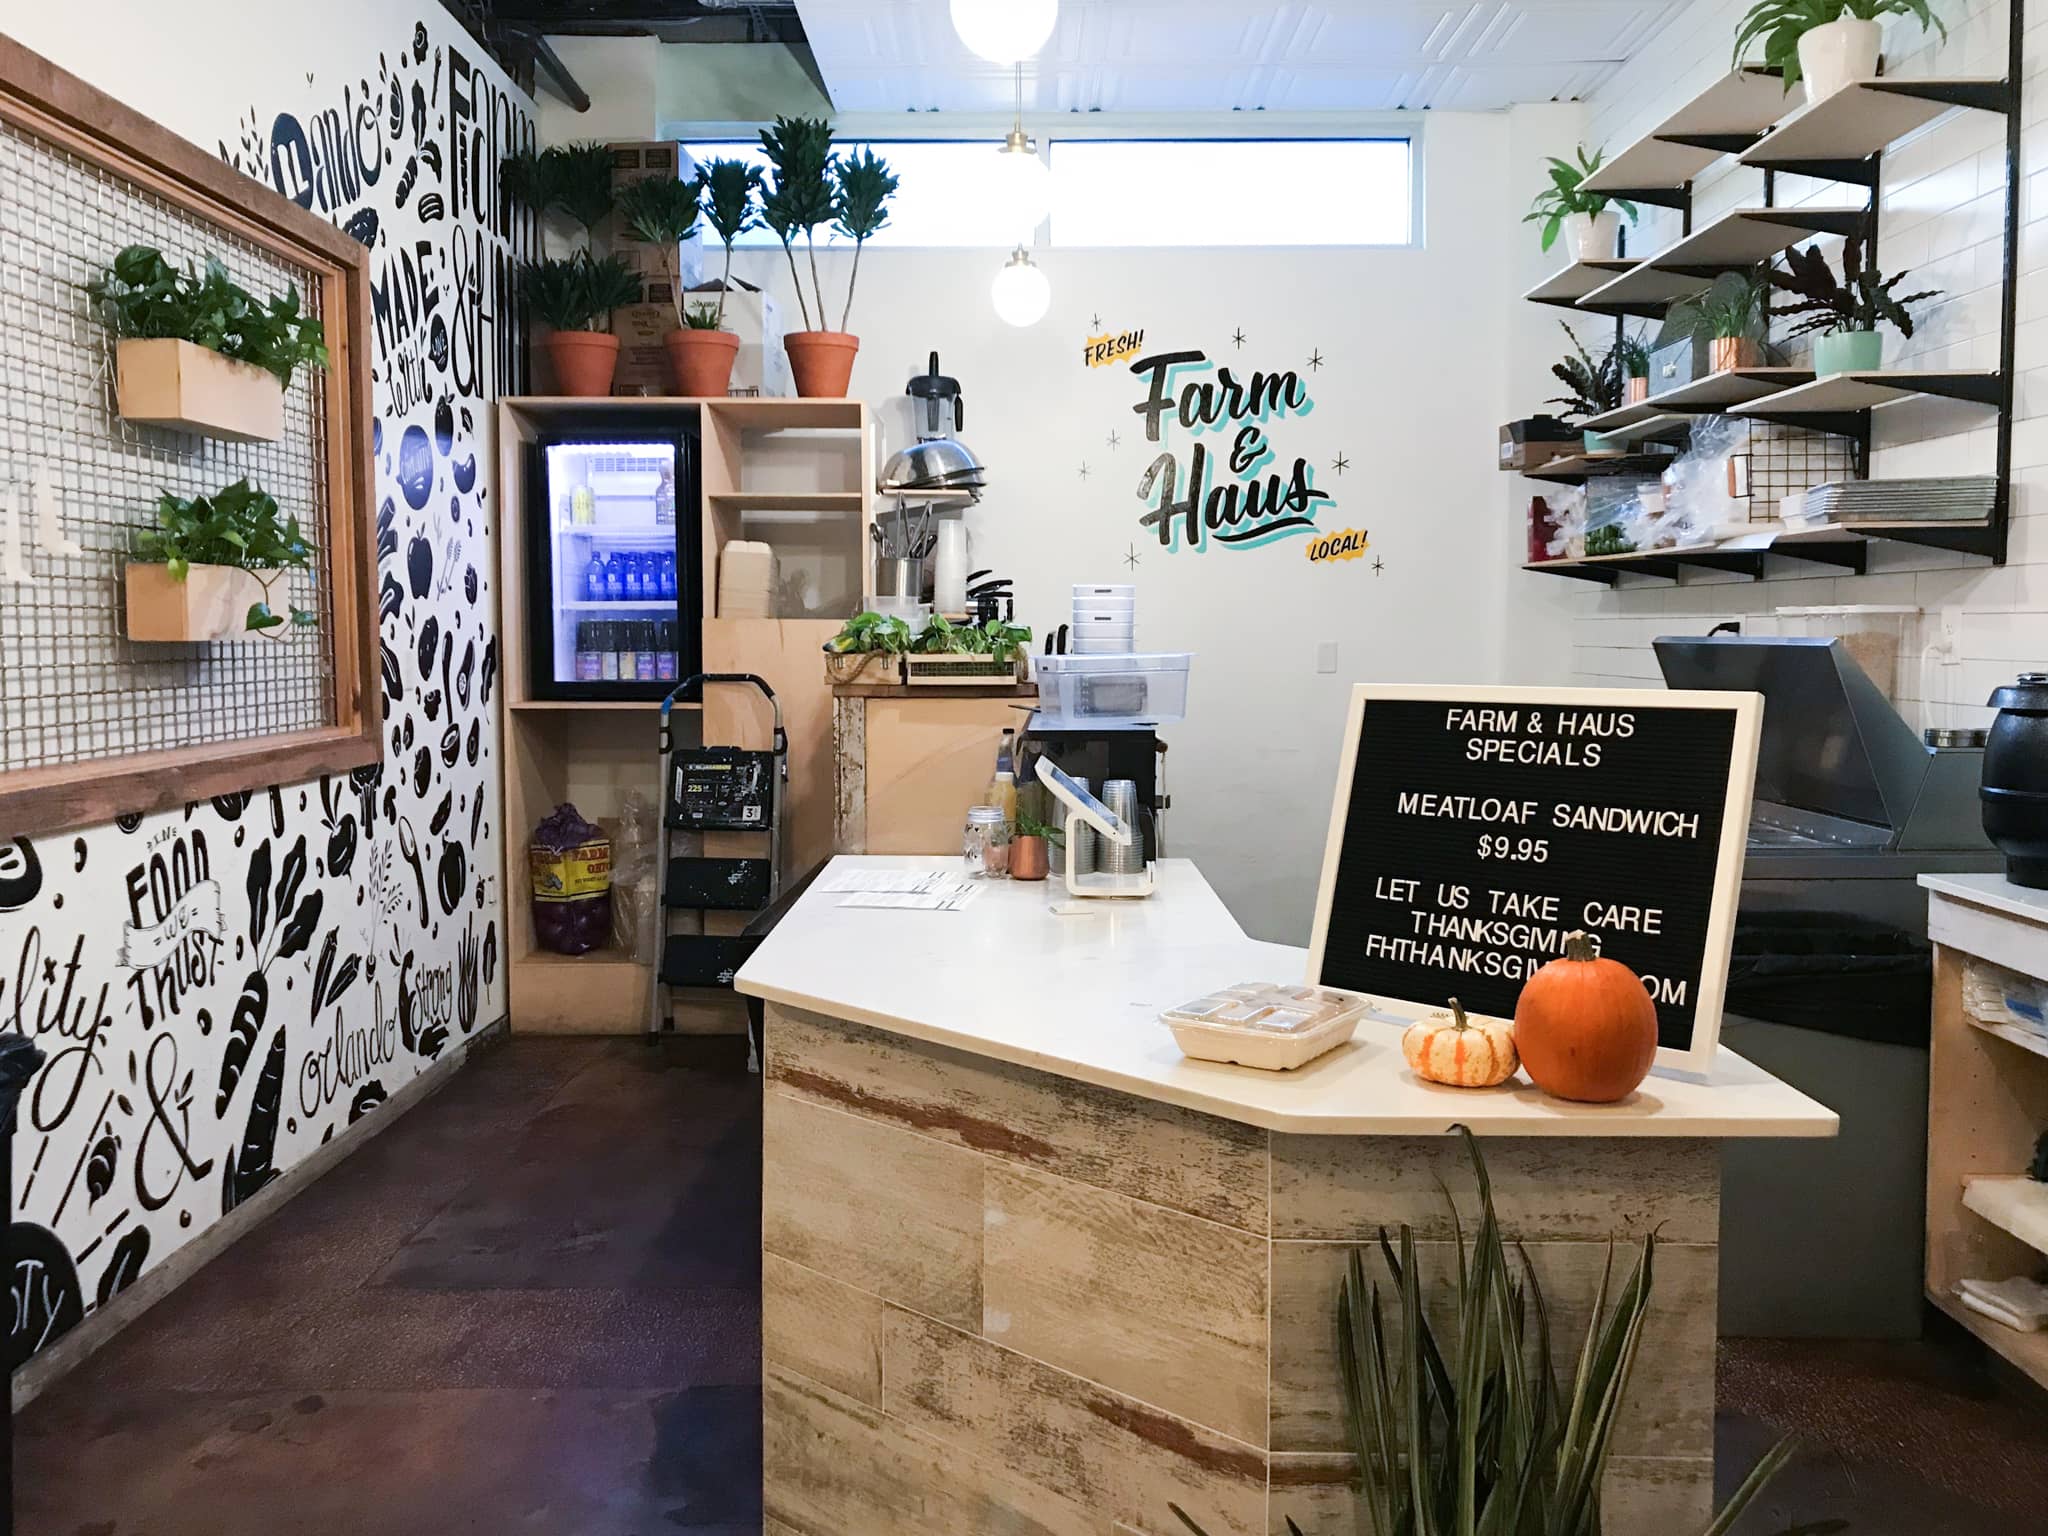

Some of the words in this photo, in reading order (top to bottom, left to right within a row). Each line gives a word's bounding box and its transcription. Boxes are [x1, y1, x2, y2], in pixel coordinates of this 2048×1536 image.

[370, 240, 440, 362] MADE
[1084, 329, 1144, 367] FRESH!
[386, 339, 433, 418] with
[1129, 350, 1306, 442] Farm
[1229, 426, 1267, 474] &
[1136, 443, 1330, 546] Haus
[1310, 530, 1368, 562] LOCAL!
[1446, 708, 1519, 733] FARM
[1527, 712, 1543, 734] &
[1557, 713, 1636, 738] HAUS
[1466, 738, 1602, 767] SPECIALS
[687, 784, 703, 793] 225
[746, 807, 754, 818] 3
[1397, 792, 1538, 825] MEATLOAF
[1552, 803, 1699, 839] SANDWICH
[1477, 834, 1549, 863] $9.95
[126, 829, 210, 929] FOOD
[1375, 877, 1421, 903] LET
[1437, 883, 1470, 909] US
[1488, 890, 1560, 922] TAKE
[1583, 902, 1663, 934] CARE
[134, 1032, 214, 1212] &
